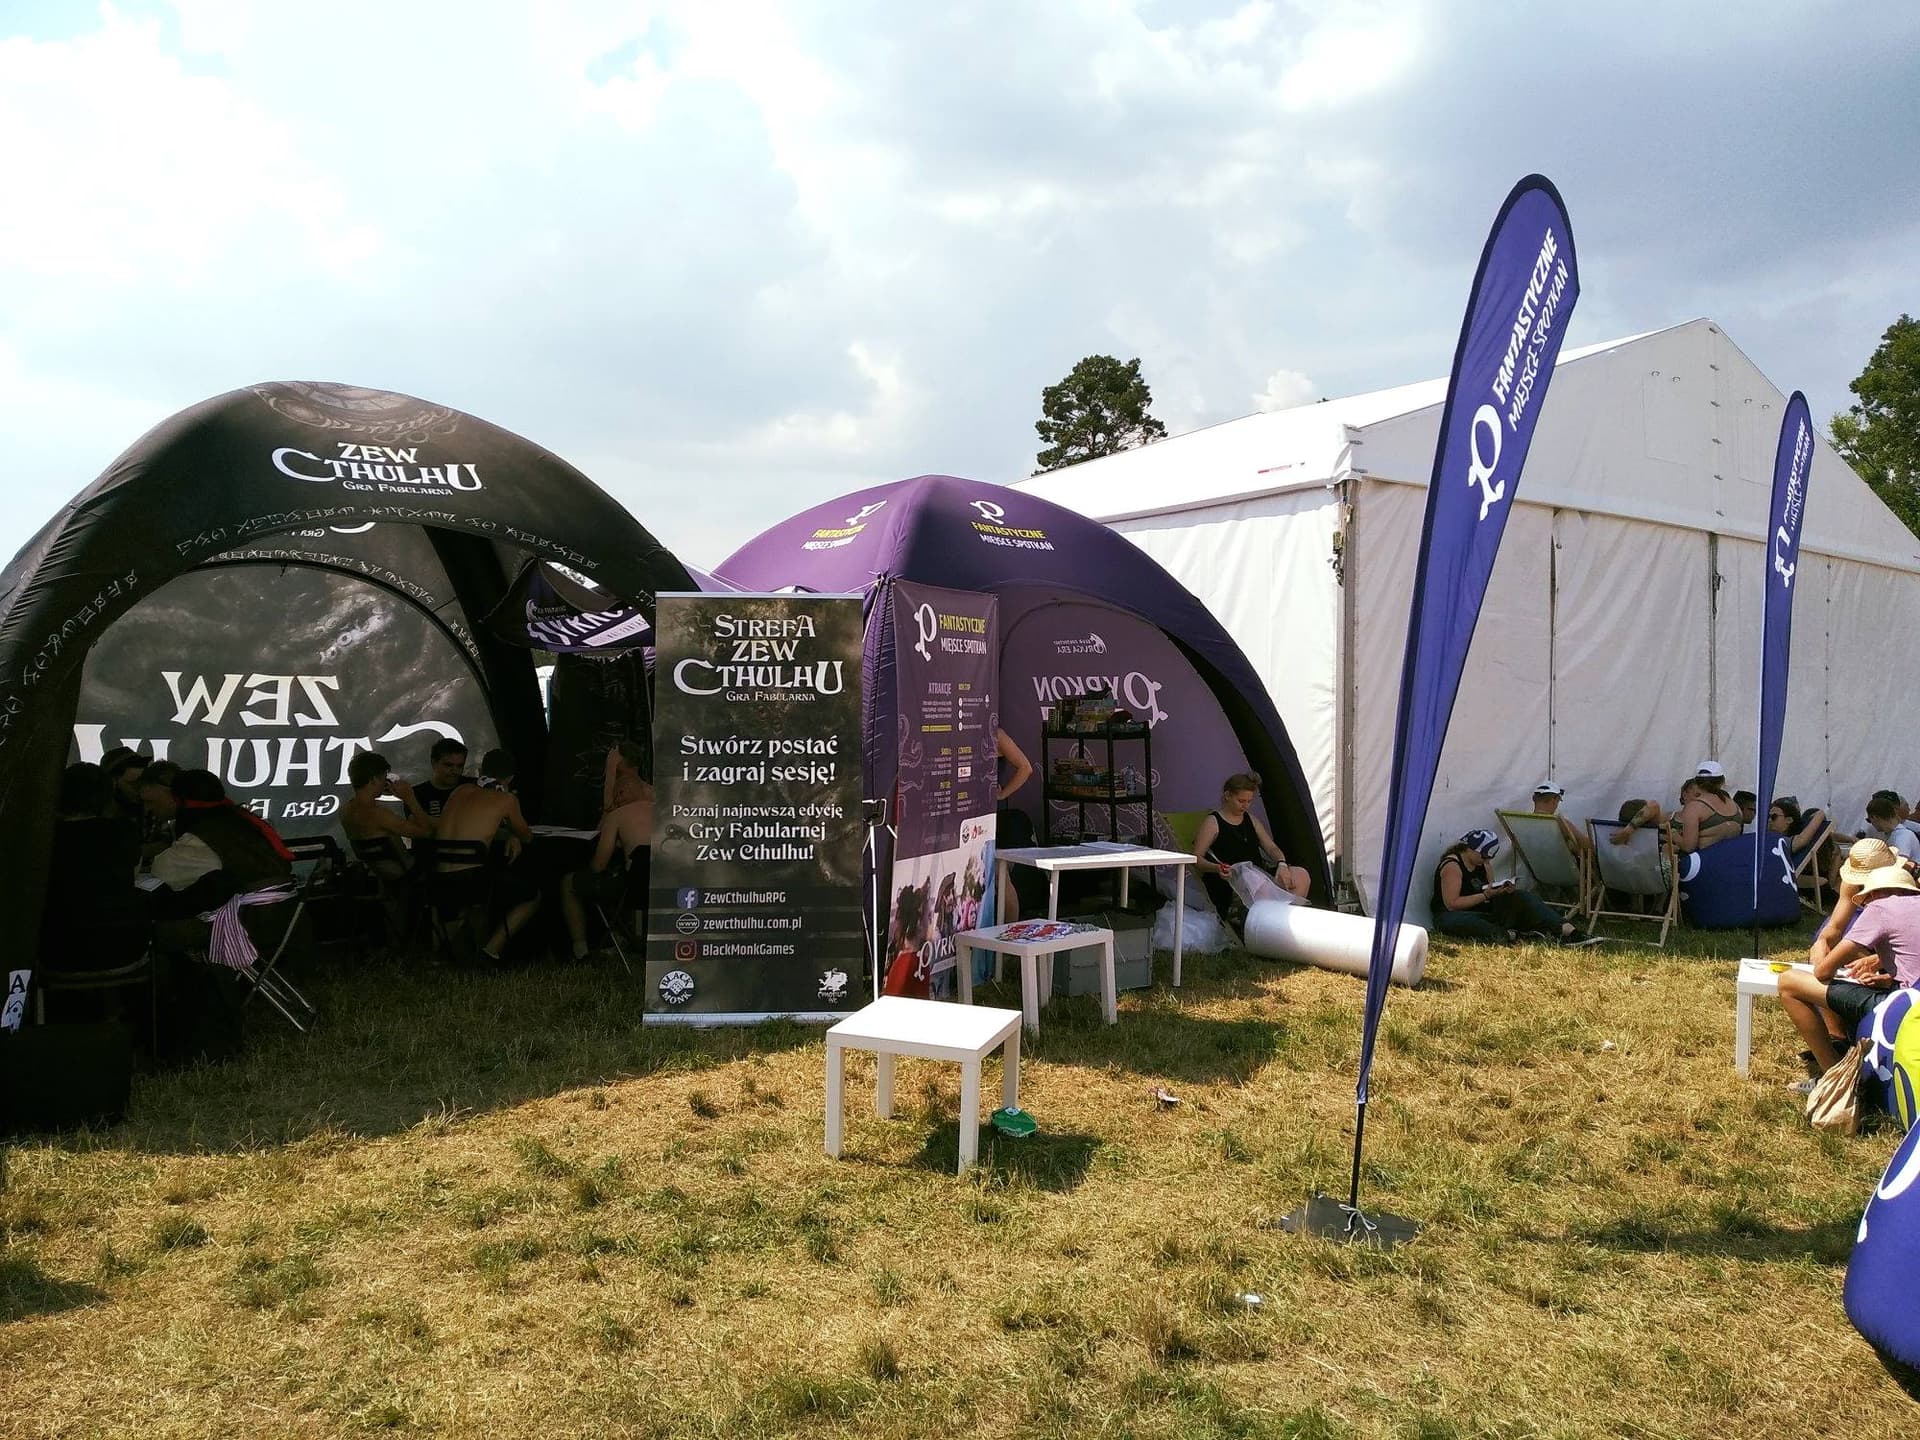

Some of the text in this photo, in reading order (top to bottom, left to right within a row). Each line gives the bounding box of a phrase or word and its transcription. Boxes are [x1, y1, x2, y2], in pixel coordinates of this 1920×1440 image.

[1492, 228, 1558, 405] FANTASTYCZNE
[1508, 258, 1569, 431] MIEJSCE SPOTKAŃ
[337, 442, 417, 464] ZEW
[272, 448, 482, 491] CTHULHU
[971, 521, 1046, 539] FANTASTYCZNE
[714, 614, 816, 638] STREFA
[939, 614, 985, 634] FANTASTYCZNE
[731, 639, 799, 662] ZEW
[673, 658, 844, 695] CTHULHU
[726, 690, 816, 702] GRA FABULARNA
[680, 735, 838, 758] Stwórz postać
[683, 761, 836, 785] i zagraj sesję!
[672, 803, 844, 819] Poznaj najnowszą edycję
[689, 822, 826, 841] Gry Fabularnej
[696, 844, 814, 861] Zew Cthulhu!
[704, 891, 786, 904] ZewCthulhuRPG
[703, 916, 802, 930] zewcthulhu.com.pl
[702, 943, 795, 957] BlackMonkGames
[914, 935, 957, 981] PYRK
[661, 972, 692, 987] BLACK
[662, 991, 692, 1004] MONK
